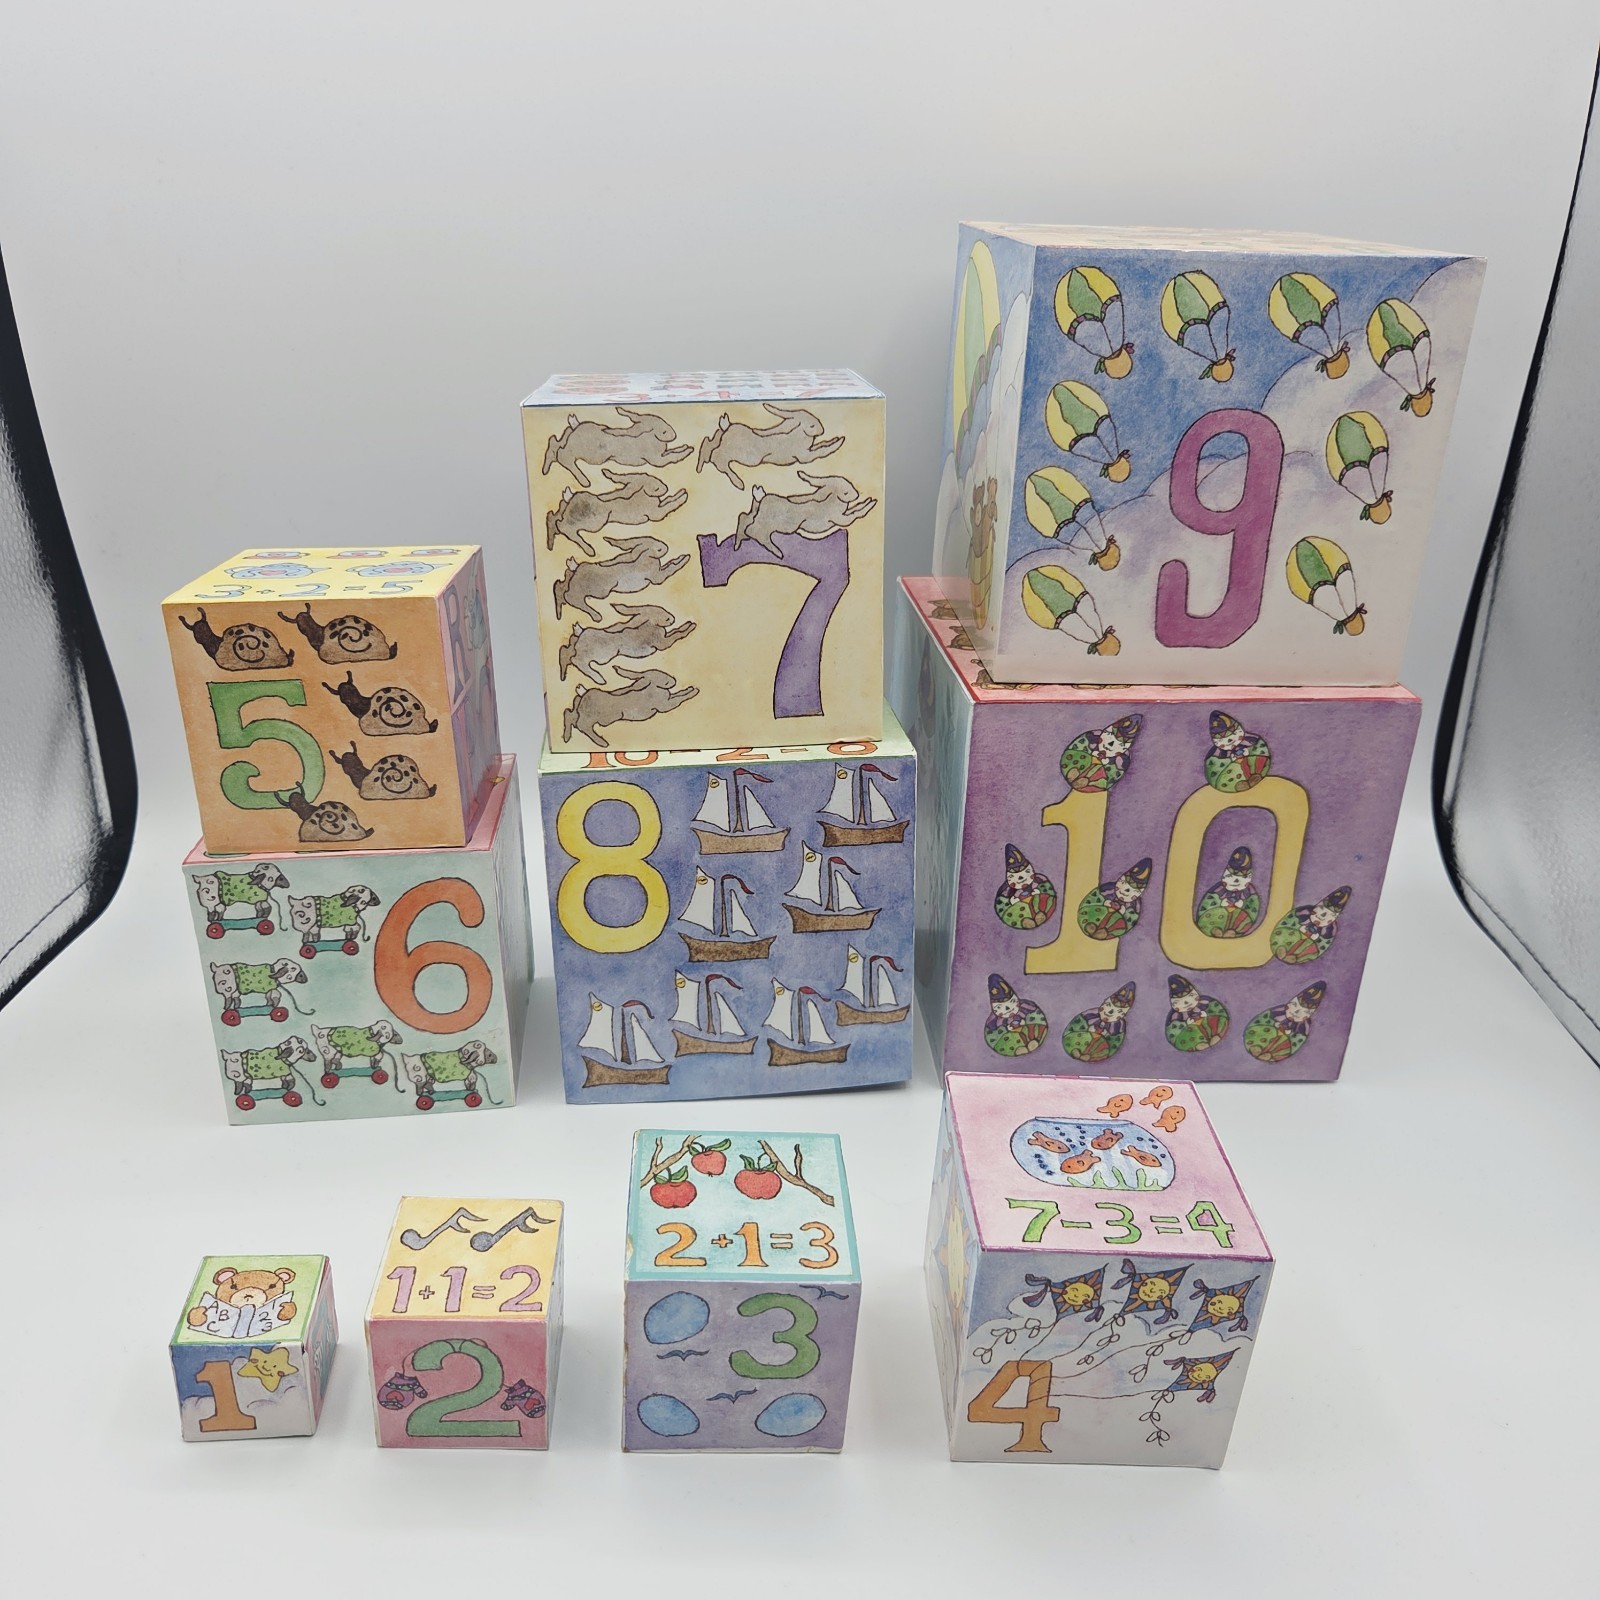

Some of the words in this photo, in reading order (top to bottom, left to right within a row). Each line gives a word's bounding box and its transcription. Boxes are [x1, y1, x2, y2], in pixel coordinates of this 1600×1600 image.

[1155, 408, 1285, 649] 9
[697, 528, 851, 719] 7
[206, 679, 325, 810] 5
[556, 780, 671, 955] 8
[1024, 775, 1311, 975] 10
[374, 876, 493, 1035] 6
[206, 1321, 220, 1333] C
[207, 1300, 219, 1315] A
[218, 1309, 231, 1322] B
[259, 1311, 272, 1322] 2
[261, 1321, 273, 1332] 3
[729, 1292, 822, 1379] 3
[195, 1360, 257, 1432] 1
[405, 1337, 523, 1438] 2
[967, 1359, 1061, 1453] 4
